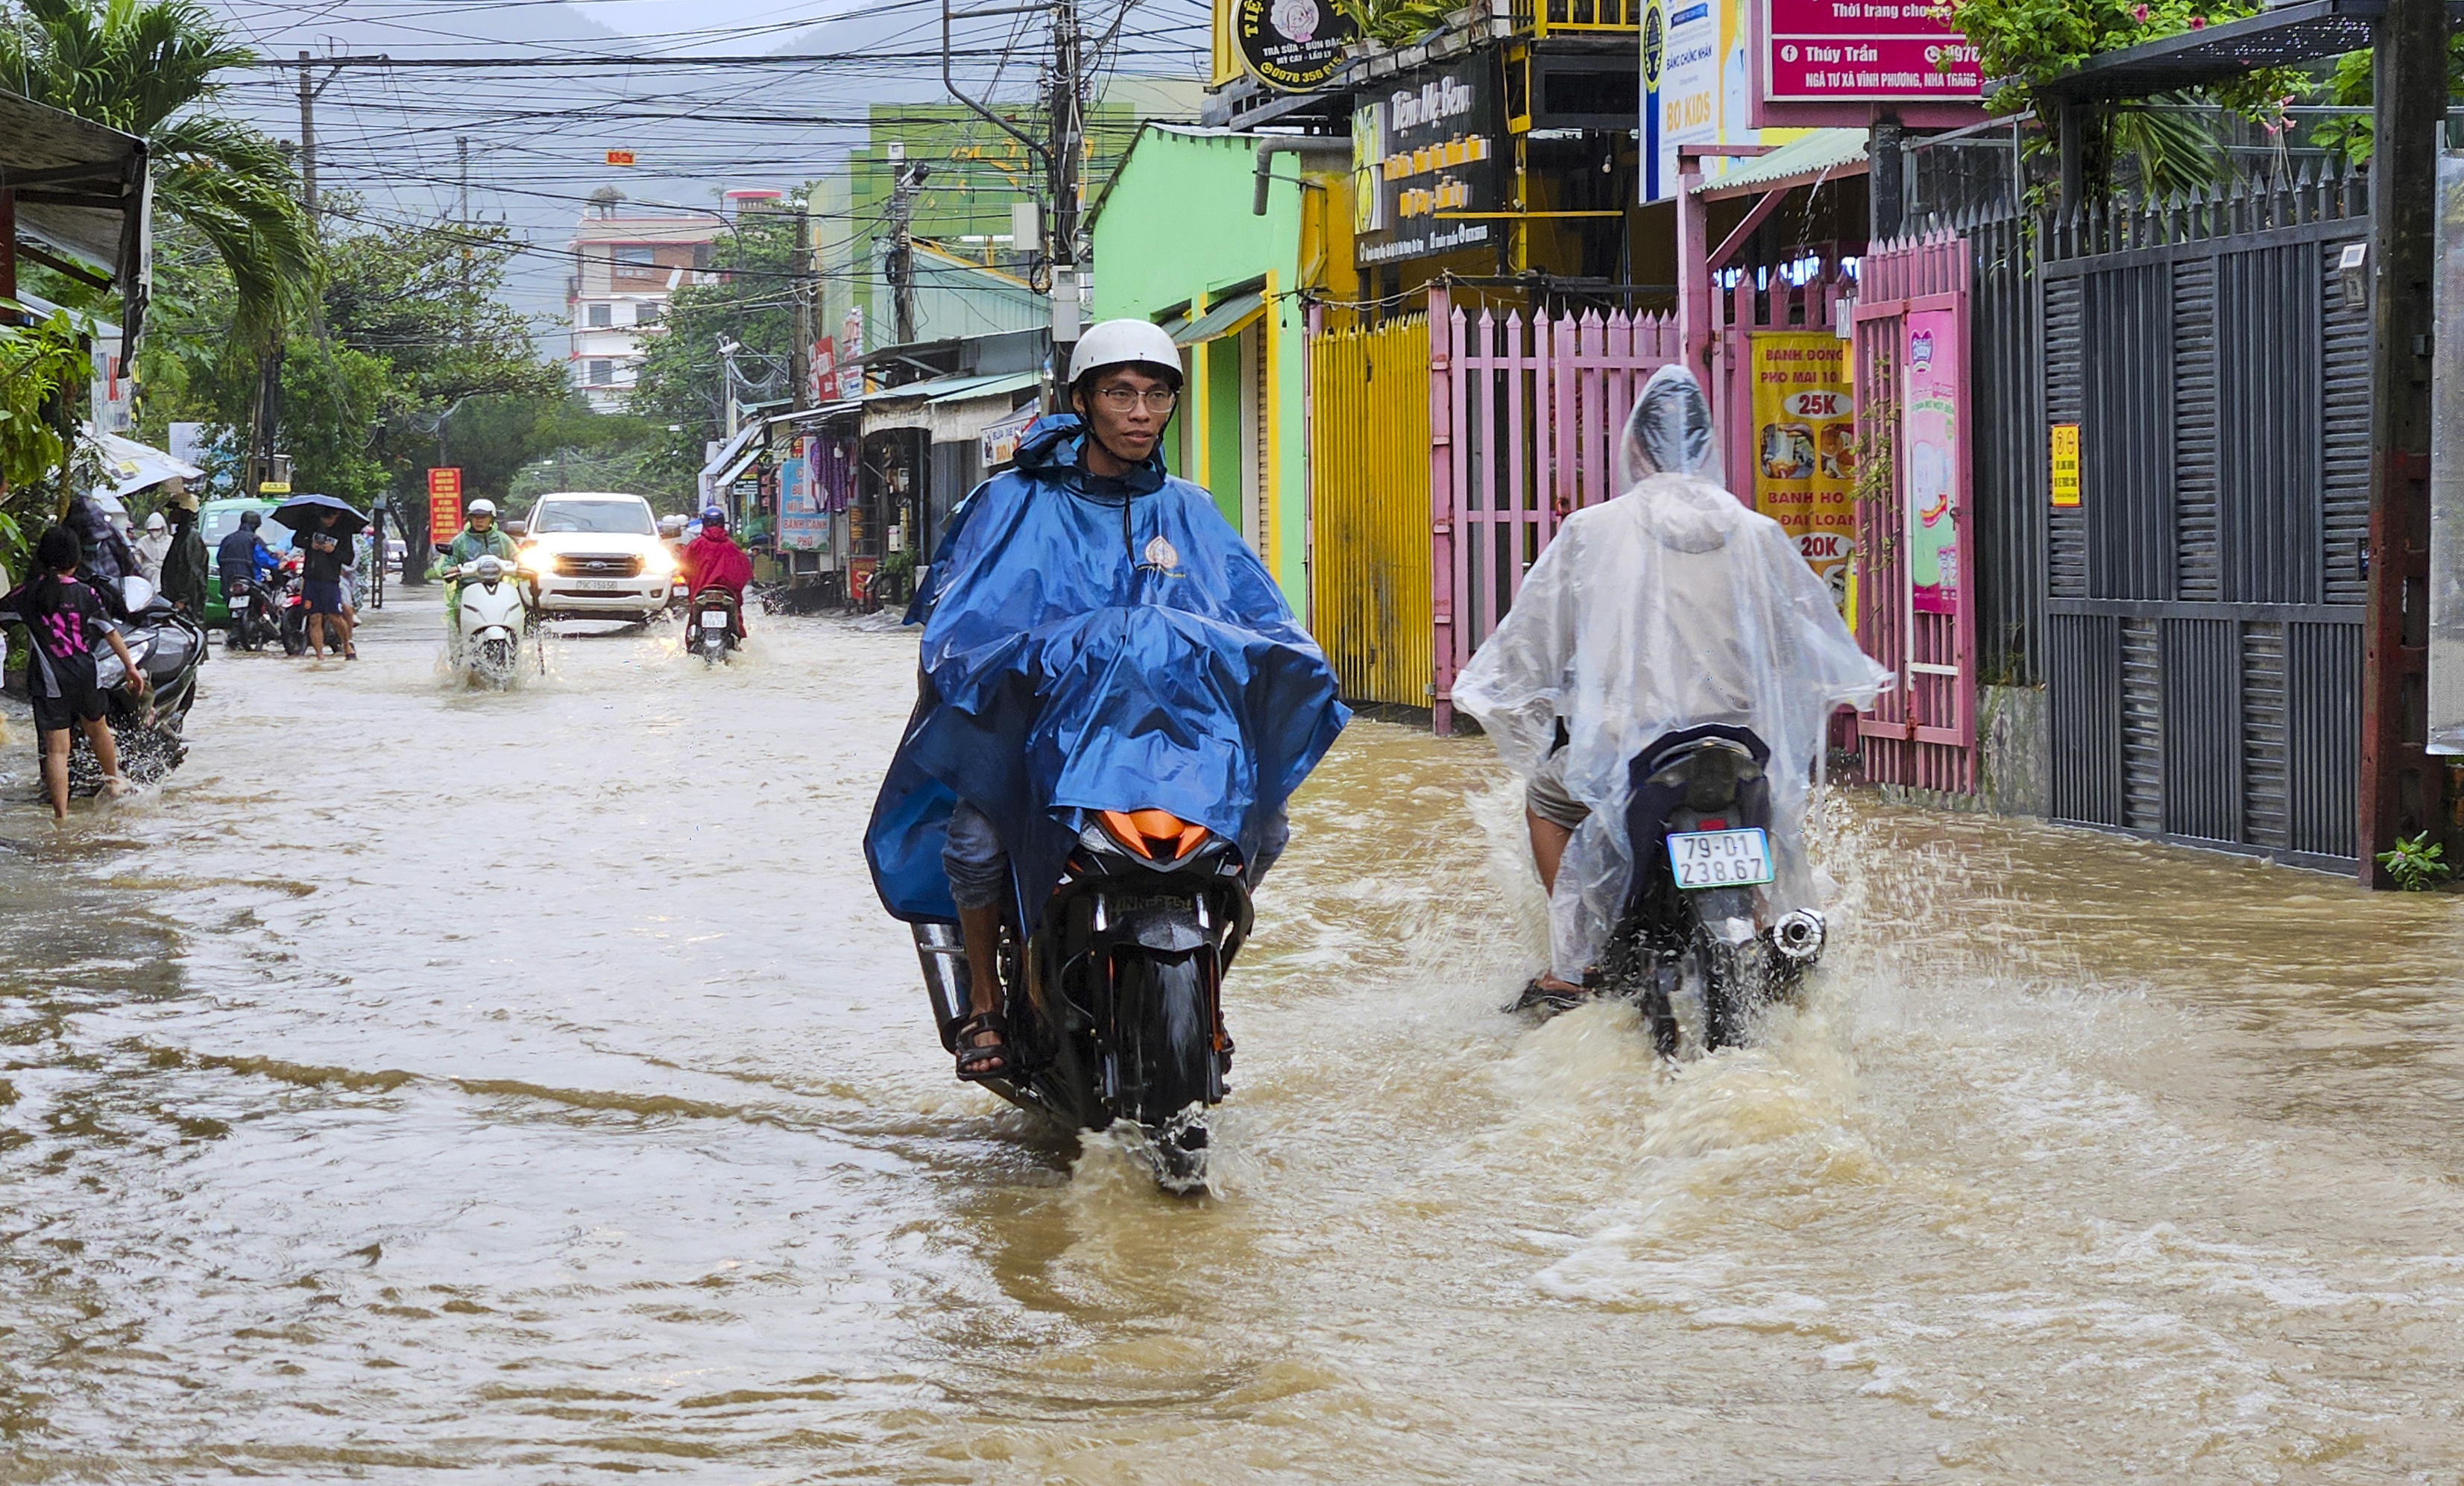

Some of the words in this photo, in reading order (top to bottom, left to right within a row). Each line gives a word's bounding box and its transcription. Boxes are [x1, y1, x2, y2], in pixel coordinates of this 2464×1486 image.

[1244, 0, 1264, 38] TIỆ
[1833, 2, 1860, 17] Thời
[1864, 4, 1899, 19] trang
[1902, 4, 1927, 17] cho
[1262, 45, 1280, 57] TRÀ
[1289, 54, 1302, 63] CAY
[1805, 45, 1841, 63] Thúy
[1844, 43, 1878, 62] Trần
[1271, 67, 1299, 83] 0978
[1805, 71, 1825, 87] NGÃ
[1827, 71, 1841, 87] TƯ
[1841, 70, 1855, 87] XÃ
[1856, 71, 1879, 87] VĨNH
[1924, 72, 1944, 87] NHA
[1947, 72, 1976, 87] TRANG
[1391, 90, 1421, 138] Tiệm
[1420, 82, 1442, 129] Mẹ
[1666, 99, 1680, 132] BO
[1685, 90, 1711, 127] KIDS
[1792, 371, 1816, 383] MAI
[1798, 394, 1837, 415] 25K
[1800, 536, 1839, 556] 20K
[1683, 834, 1748, 859] 79-D1
[1680, 858, 1761, 884] 238.67
